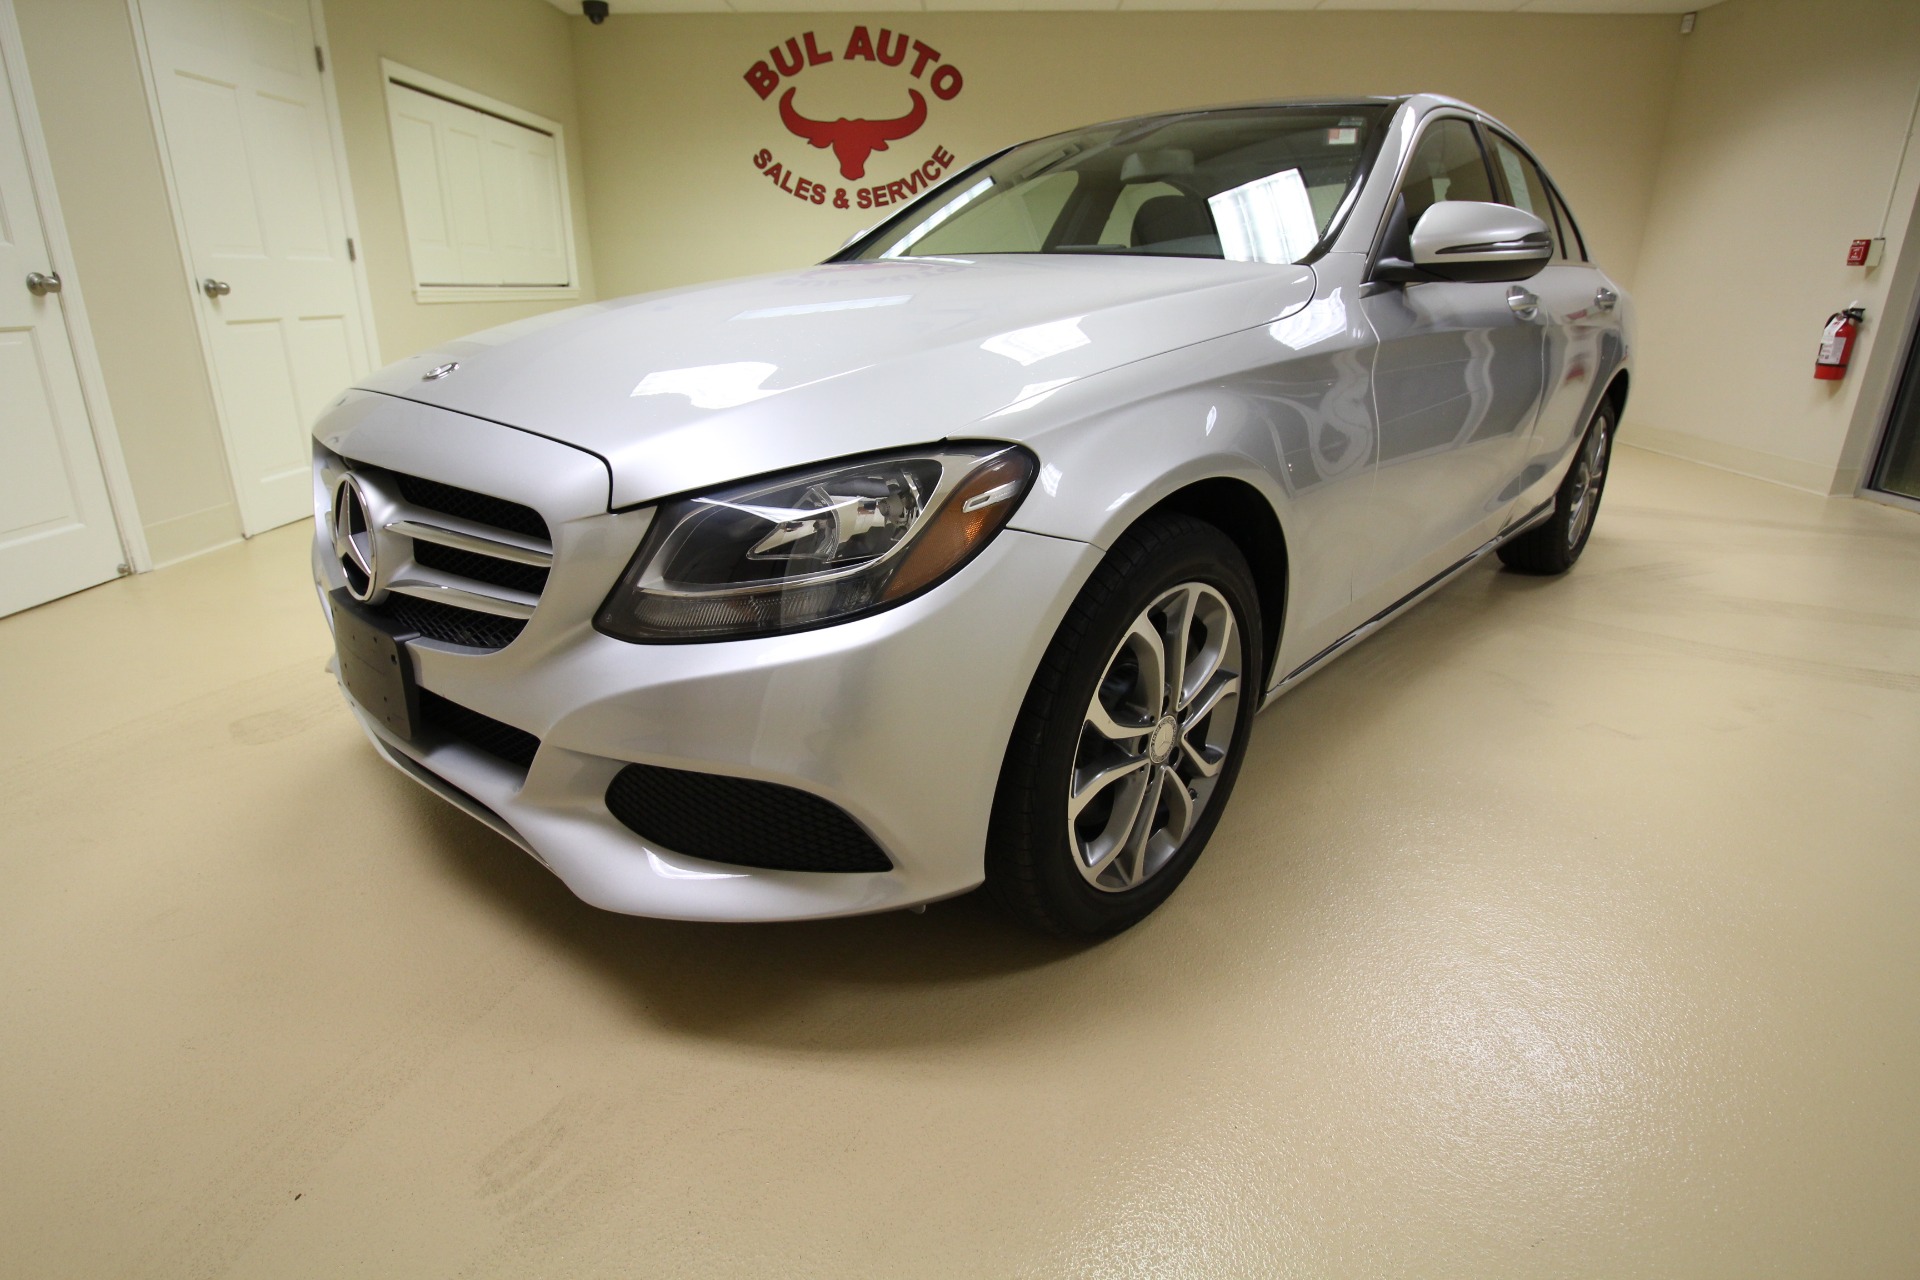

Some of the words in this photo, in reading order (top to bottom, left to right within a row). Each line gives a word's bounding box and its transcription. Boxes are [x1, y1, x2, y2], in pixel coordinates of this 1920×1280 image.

[743, 31, 834, 101] BUL
[843, 26, 963, 101] AUTO
[753, 148, 826, 205] SALES
[832, 187, 850, 209] &
[856, 145, 955, 209] SERVICE
